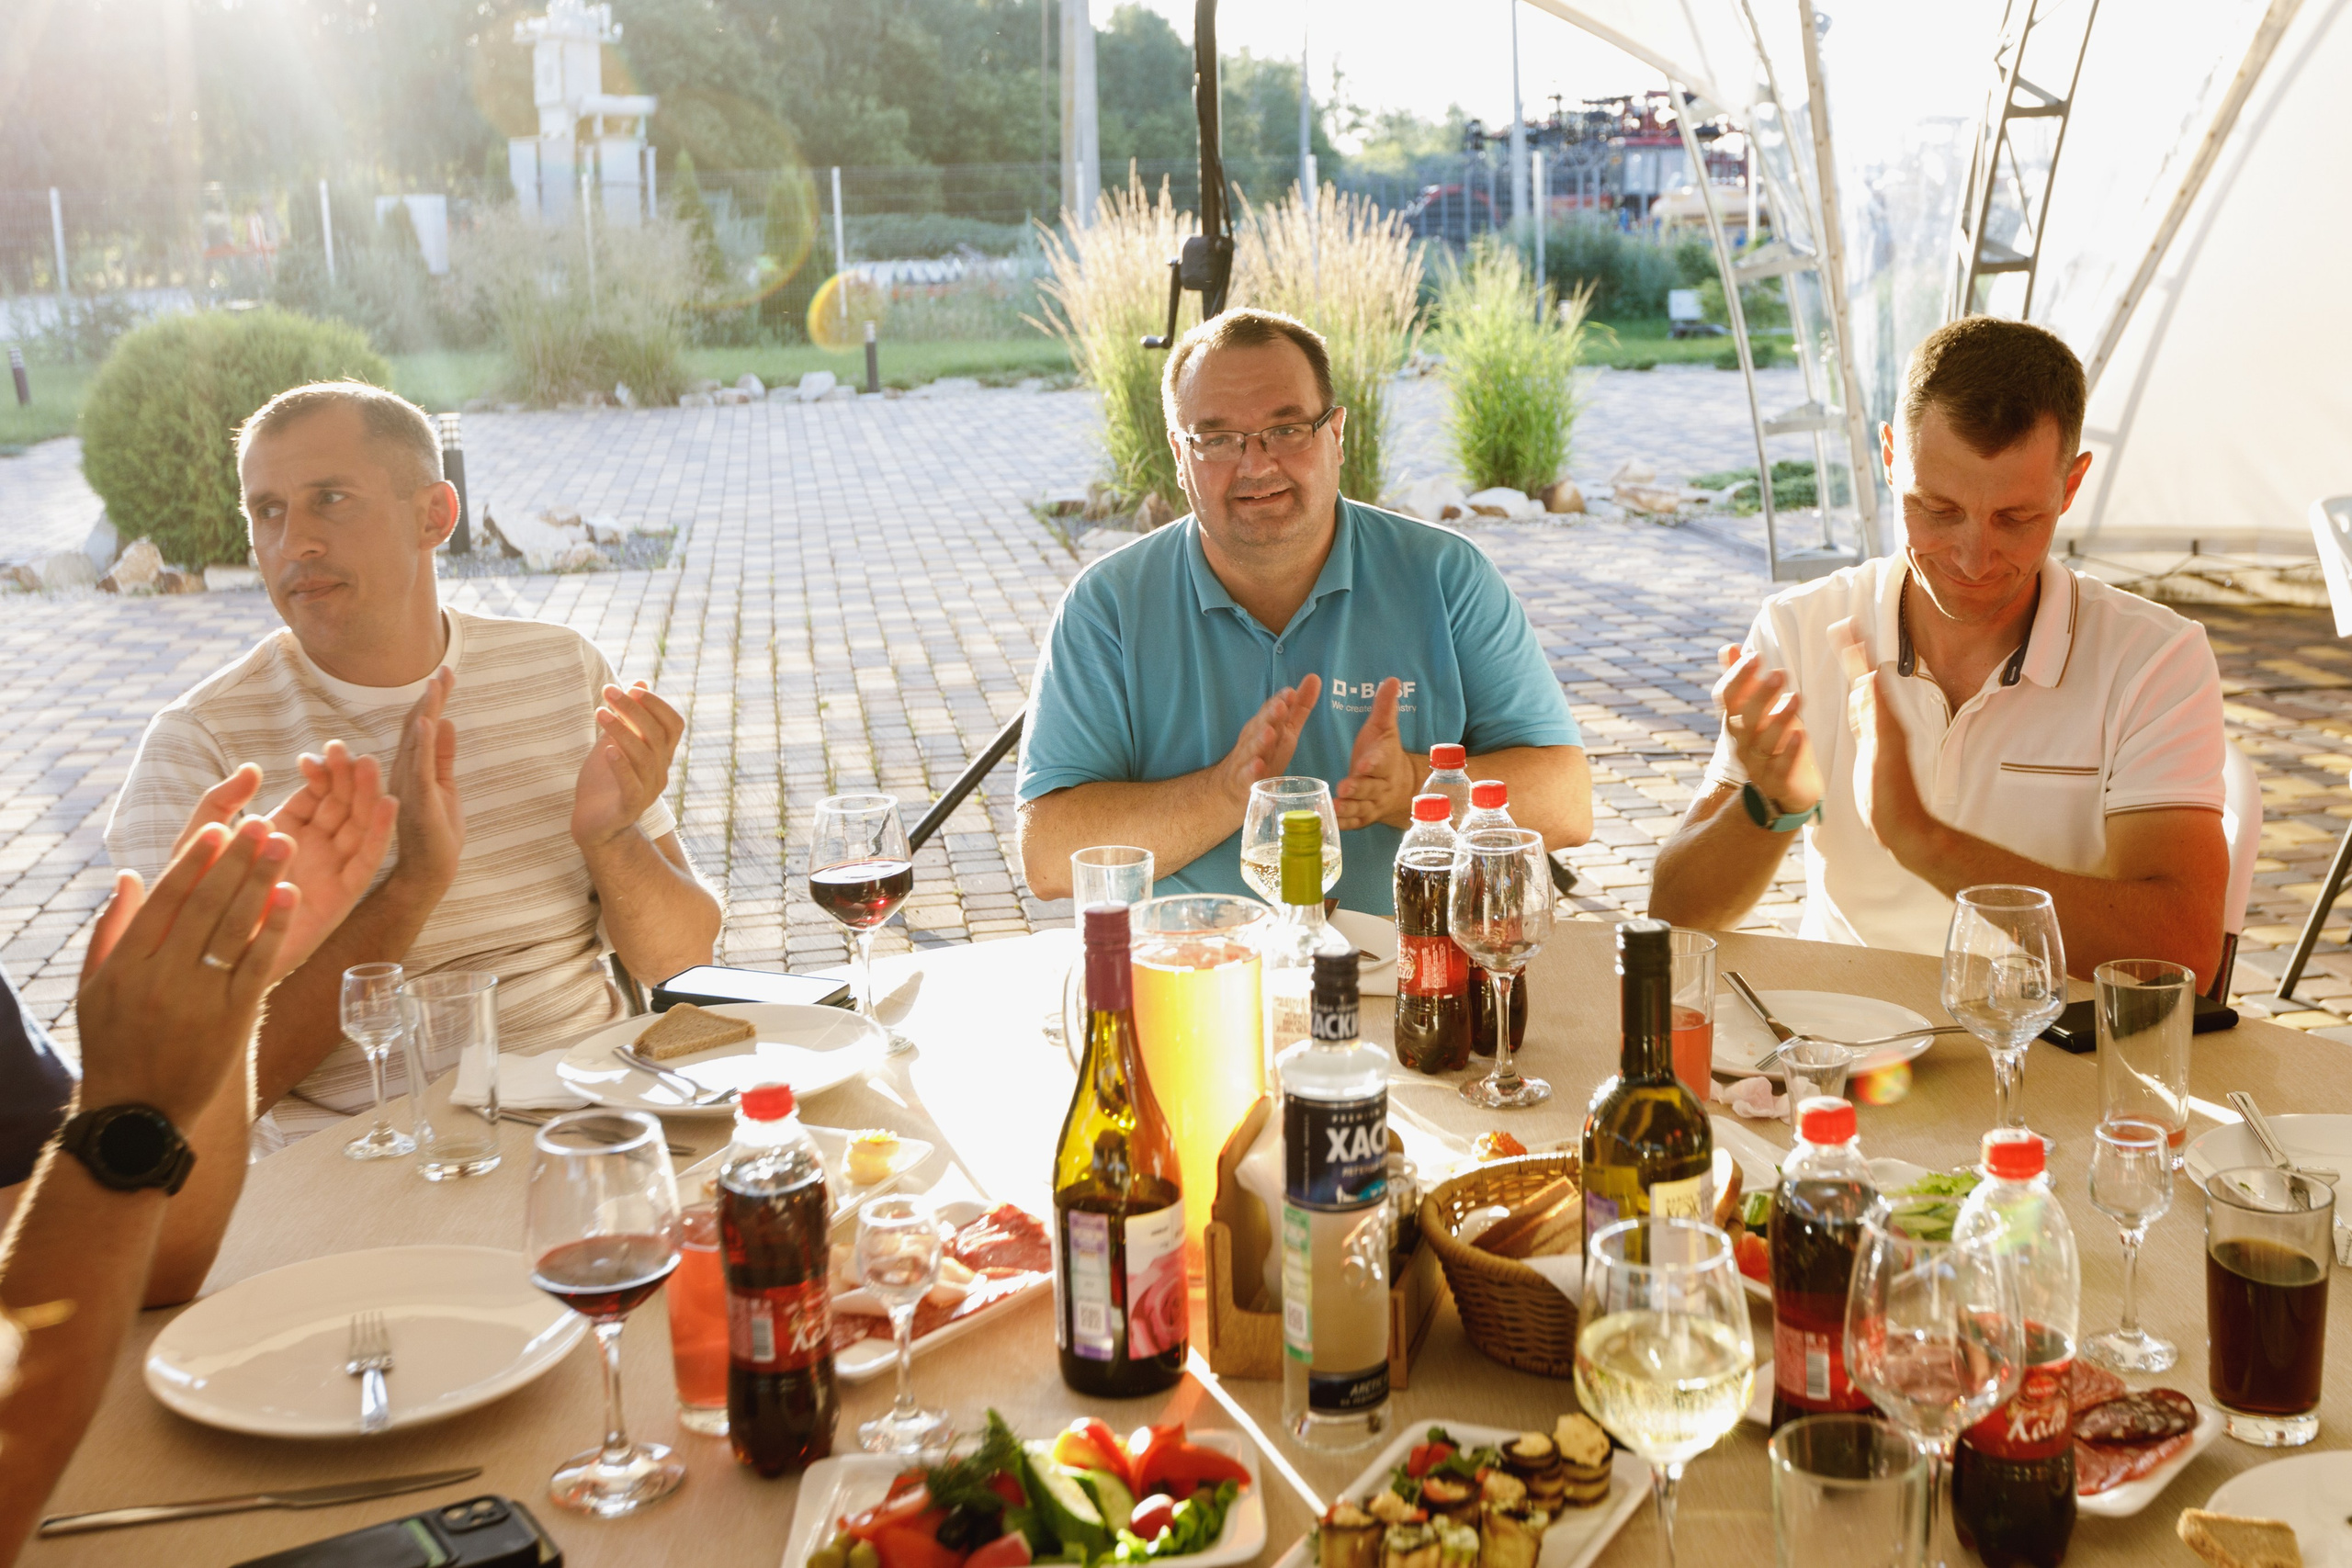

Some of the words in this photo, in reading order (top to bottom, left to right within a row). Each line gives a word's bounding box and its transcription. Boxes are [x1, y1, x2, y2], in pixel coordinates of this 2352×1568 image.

[1361, 682, 1416, 699] BF
[1331, 700, 1343, 710] We
[1345, 705, 1372, 713] create
